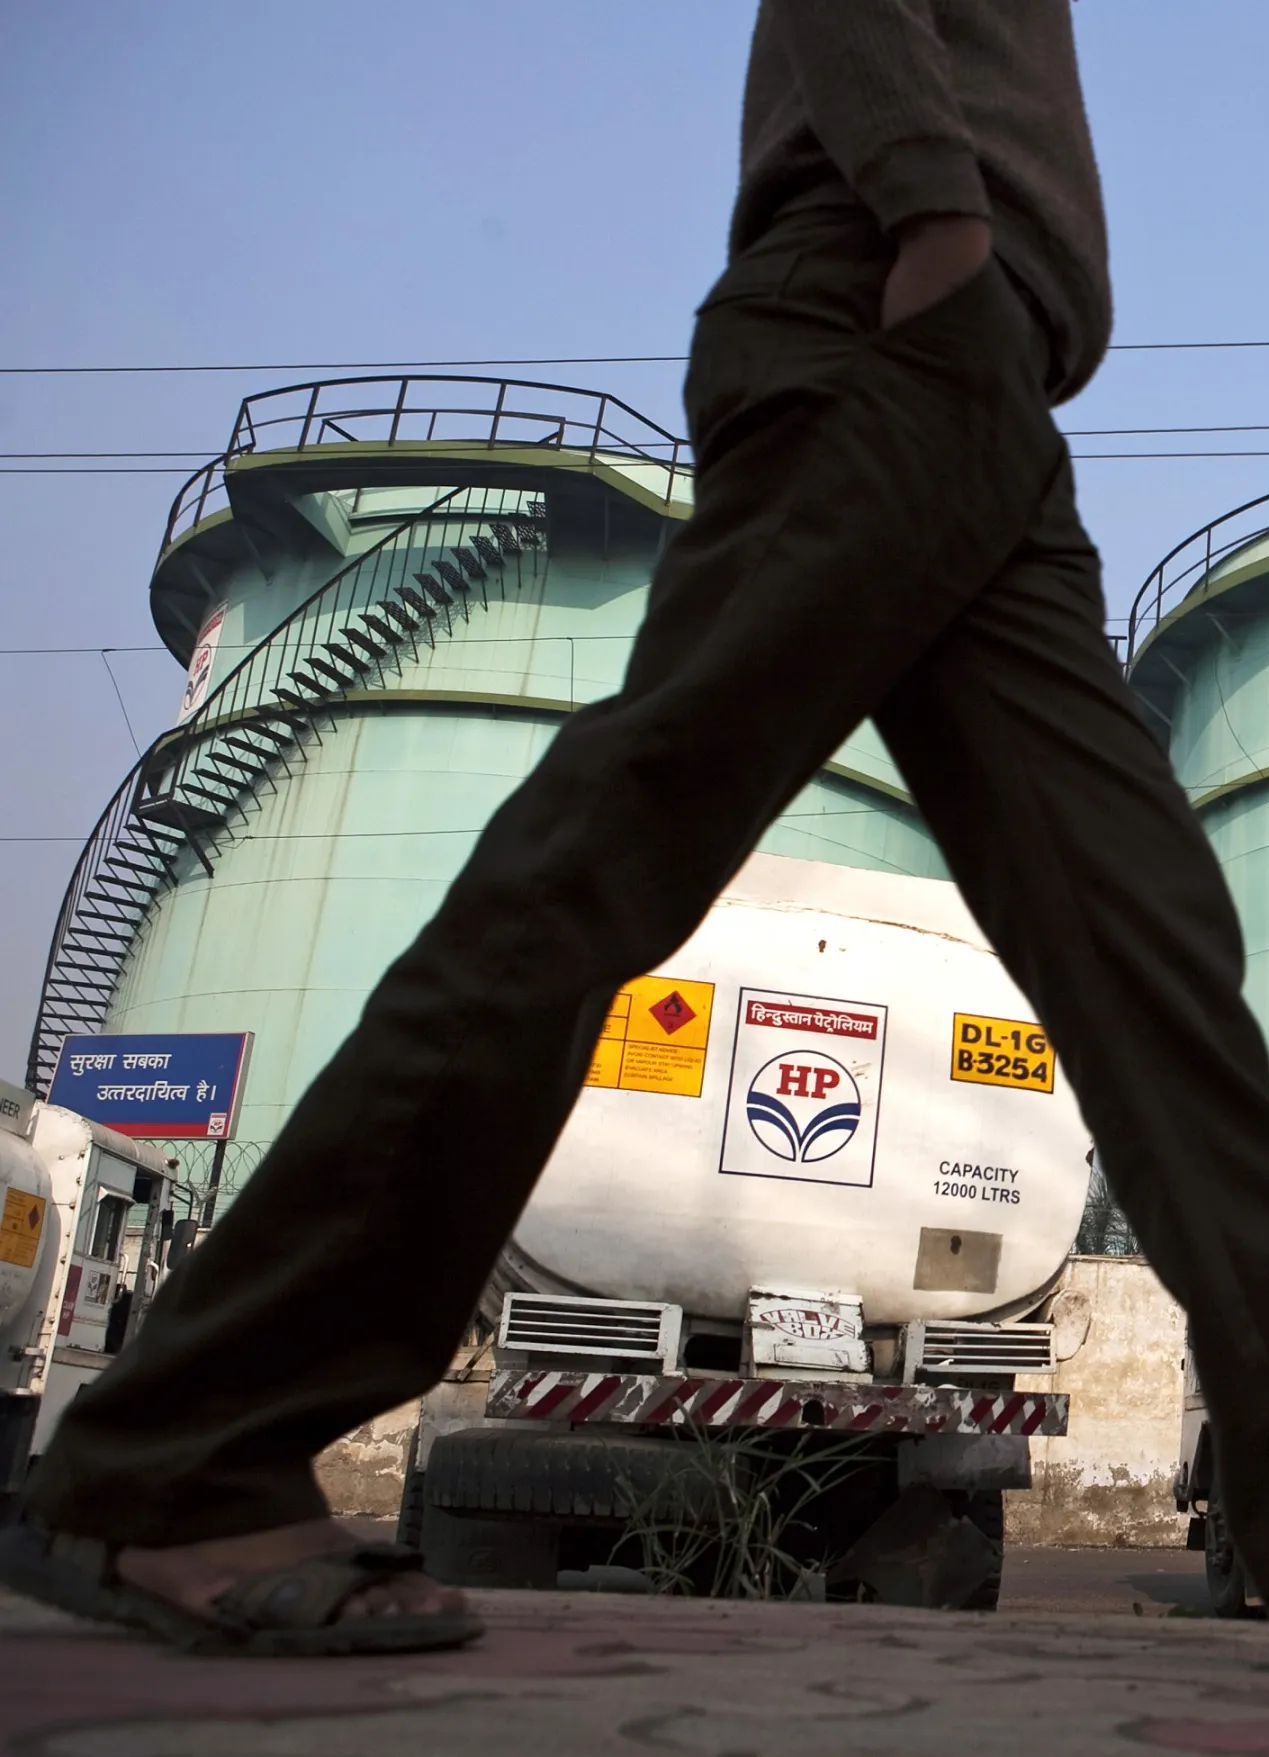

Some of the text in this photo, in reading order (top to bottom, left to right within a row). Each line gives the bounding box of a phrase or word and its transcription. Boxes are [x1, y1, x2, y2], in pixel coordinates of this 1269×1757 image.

[751, 1003, 873, 1033] हिन्दुस्तान पेट्रोलियम
[961, 1023, 1047, 1054] DL-1G
[70, 1054, 172, 1076] सुरक्षा सबका
[96, 1080, 190, 1102] उत्तरदायित्व
[776, 1063, 840, 1099] HP
[939, 1161, 1019, 1183] CAPACITY
[934, 1180, 1021, 1204] 12000 LTRS
[761, 1310, 855, 1338] VALVE
[777, 1323, 845, 1340] BOX
